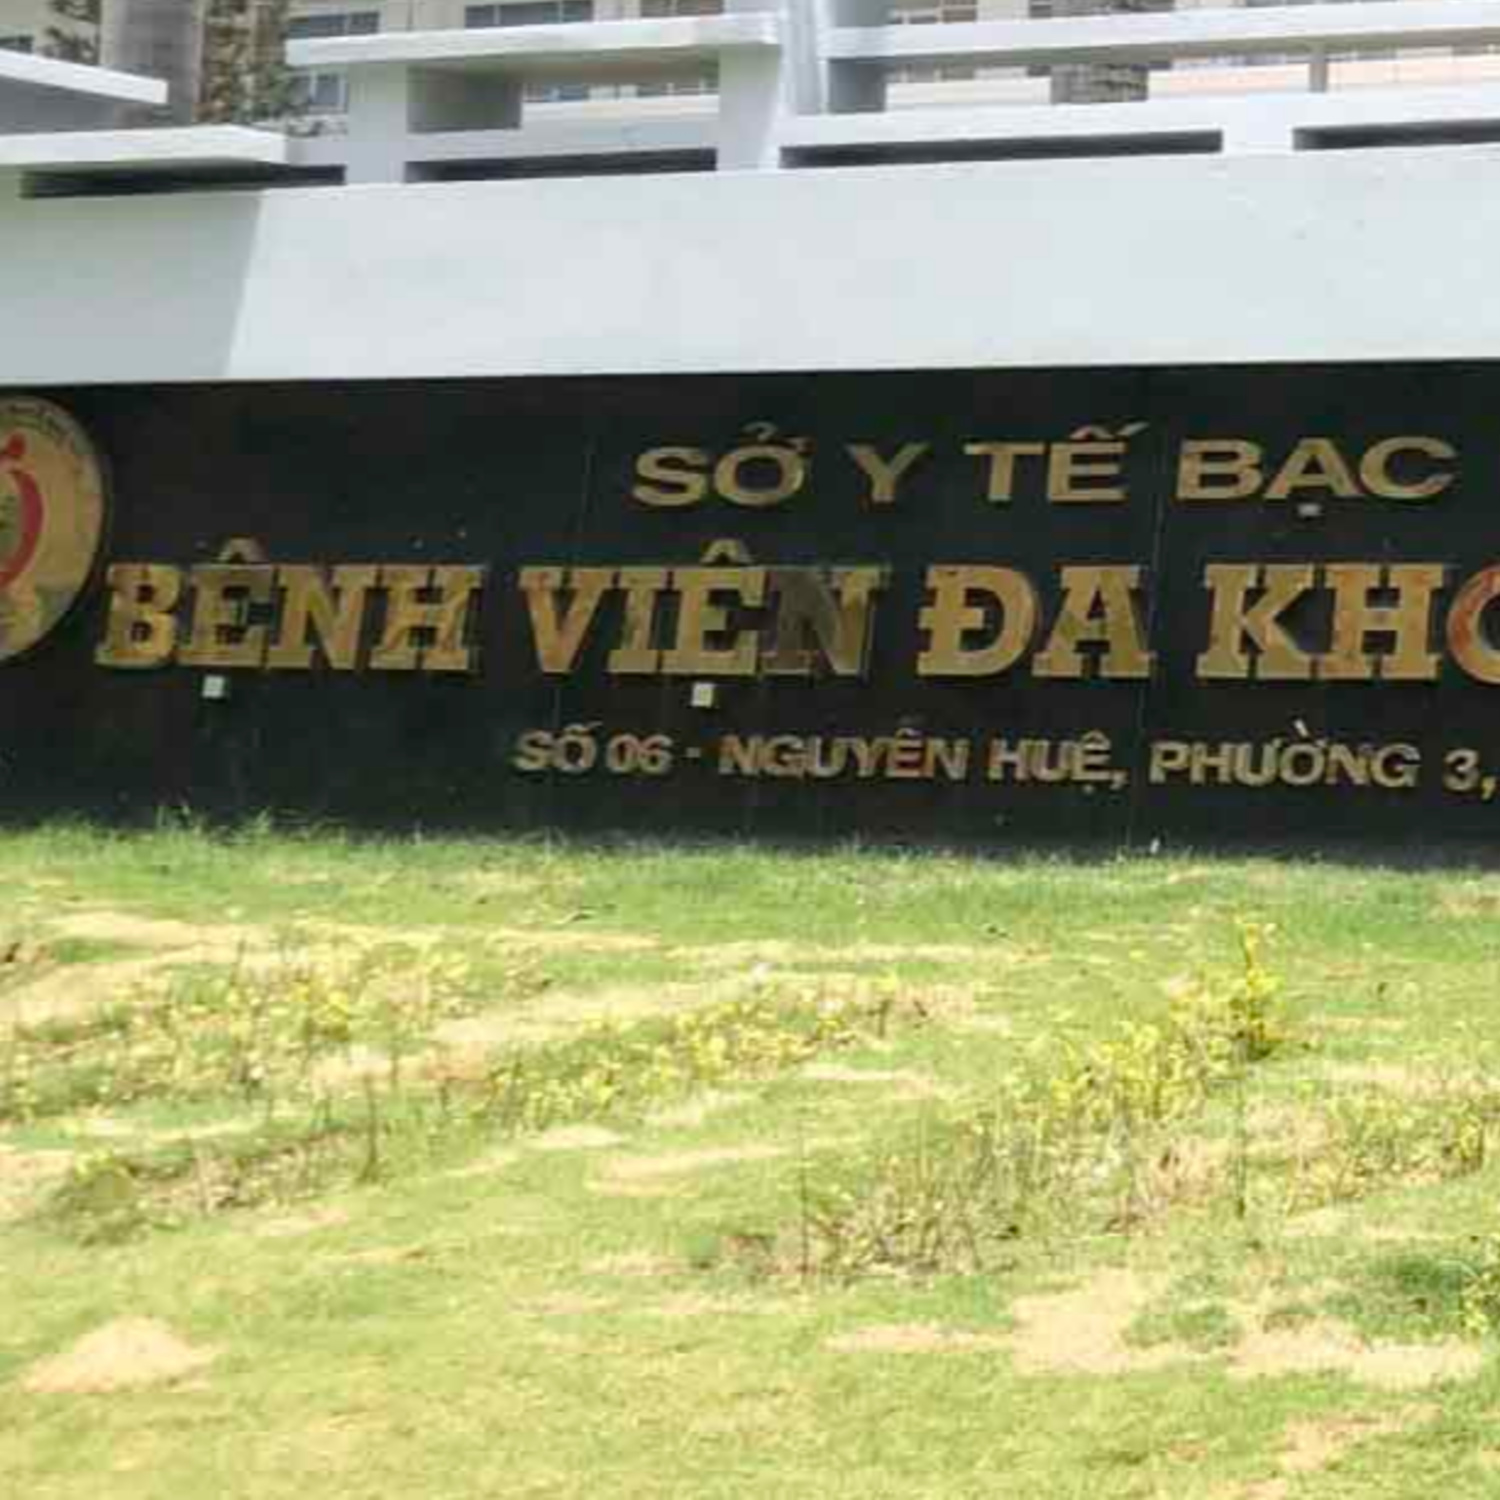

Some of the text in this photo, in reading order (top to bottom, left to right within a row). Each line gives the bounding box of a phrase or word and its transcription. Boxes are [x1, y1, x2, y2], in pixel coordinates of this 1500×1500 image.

[632, 421, 812, 506] SỞ
[845, 442, 931, 502] Y
[964, 421, 1149, 502] TẾ
[1176, 436, 1456, 518] BẠC
[94, 538, 488, 700] BỆNH
[518, 538, 888, 707] VIỆN
[916, 563, 1152, 679] ĐA
[513, 720, 603, 773] SỐ
[605, 733, 674, 774] 06
[986, 729, 1131, 794] HUỆ,
[1148, 719, 1422, 787] PHƯỜNG
[1442, 749, 1498, 800] 3,
